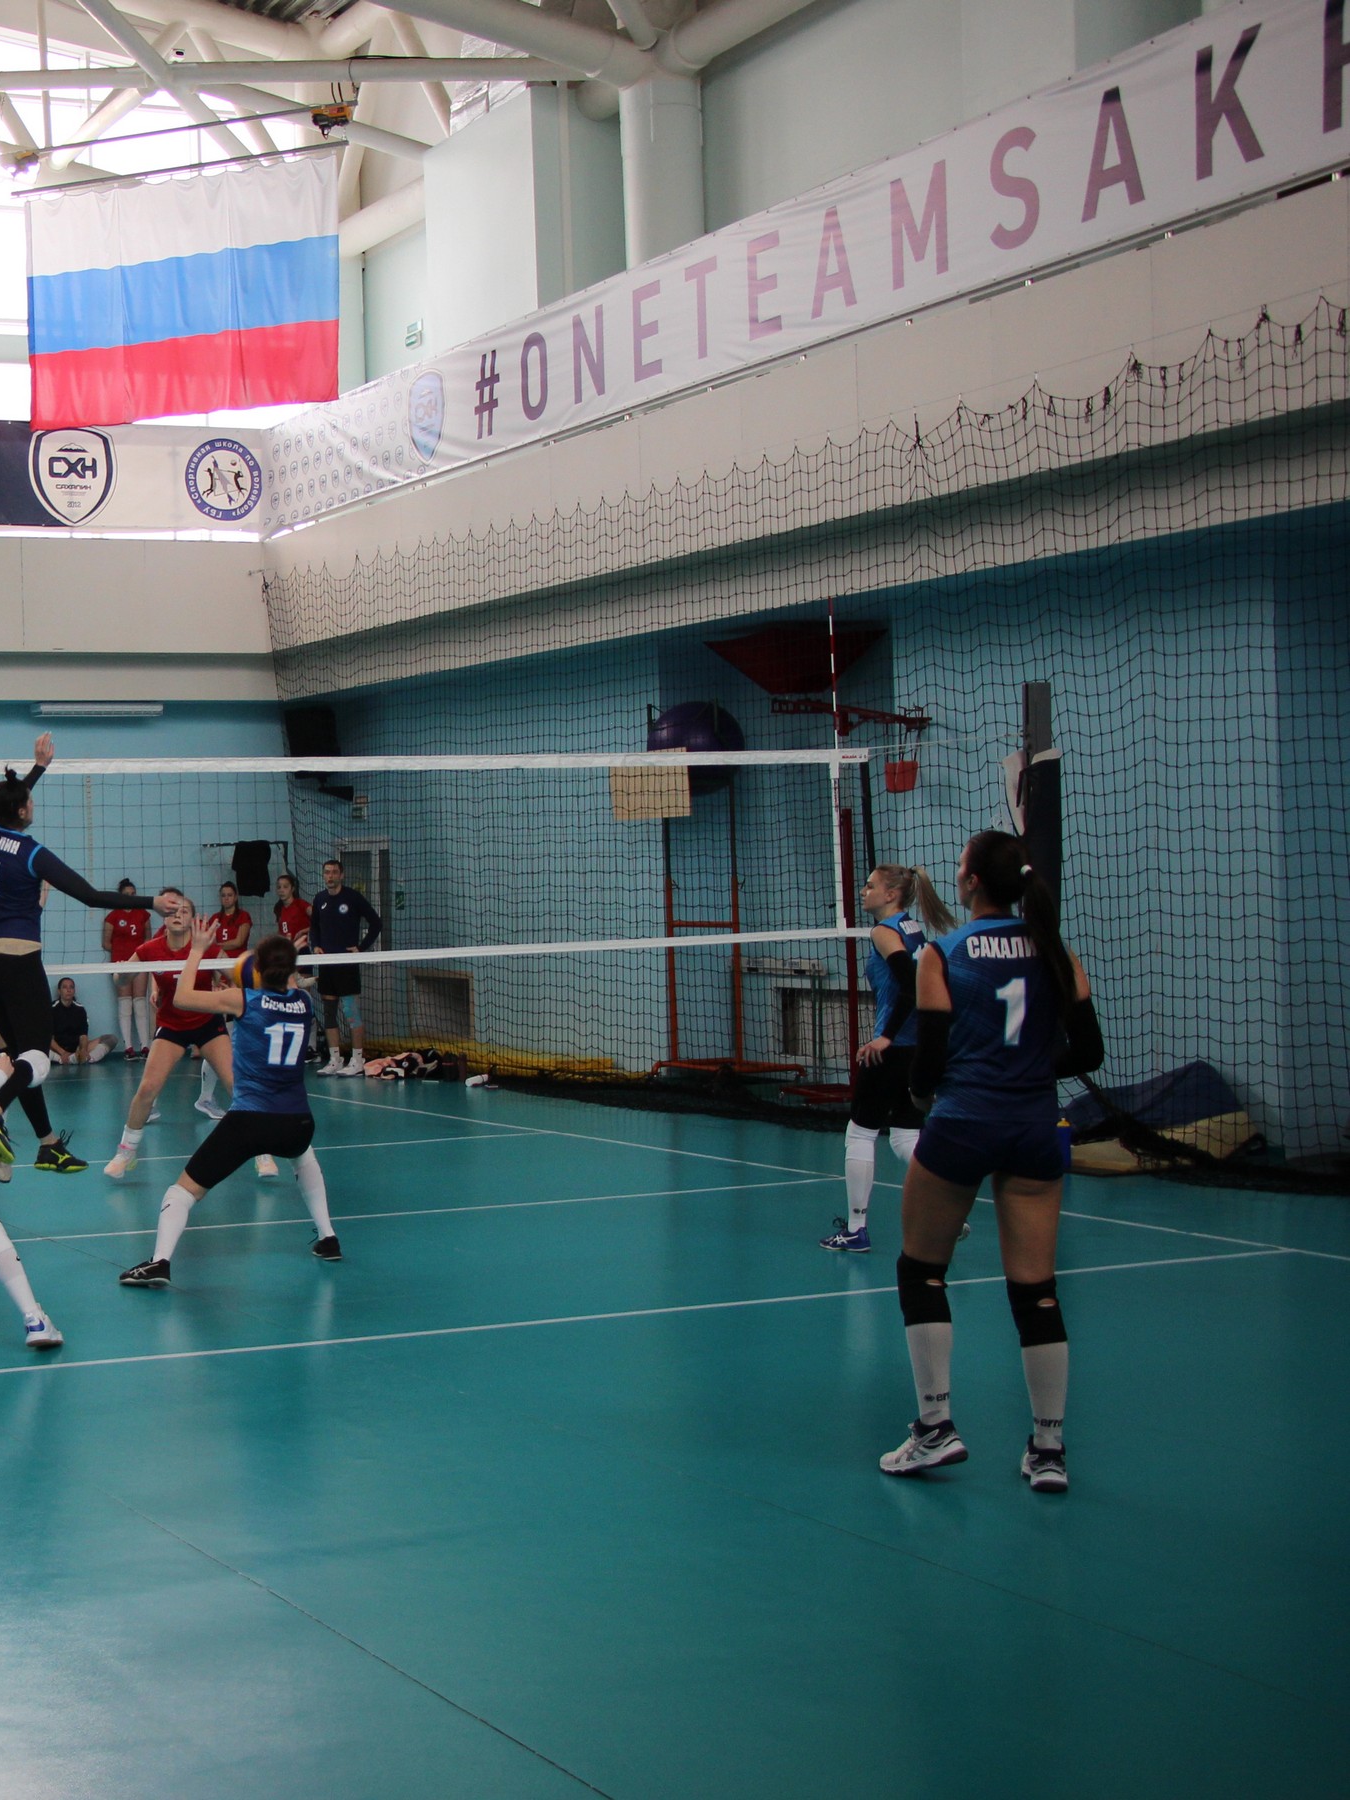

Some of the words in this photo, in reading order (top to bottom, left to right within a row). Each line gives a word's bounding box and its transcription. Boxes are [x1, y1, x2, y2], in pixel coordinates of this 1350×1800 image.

[130, 924, 137, 936] 2
[222, 928, 228, 941] 5
[966, 935, 1038, 959] САХАЛИ
[996, 977, 1027, 1046] 1
[263, 1022, 305, 1066] 17
